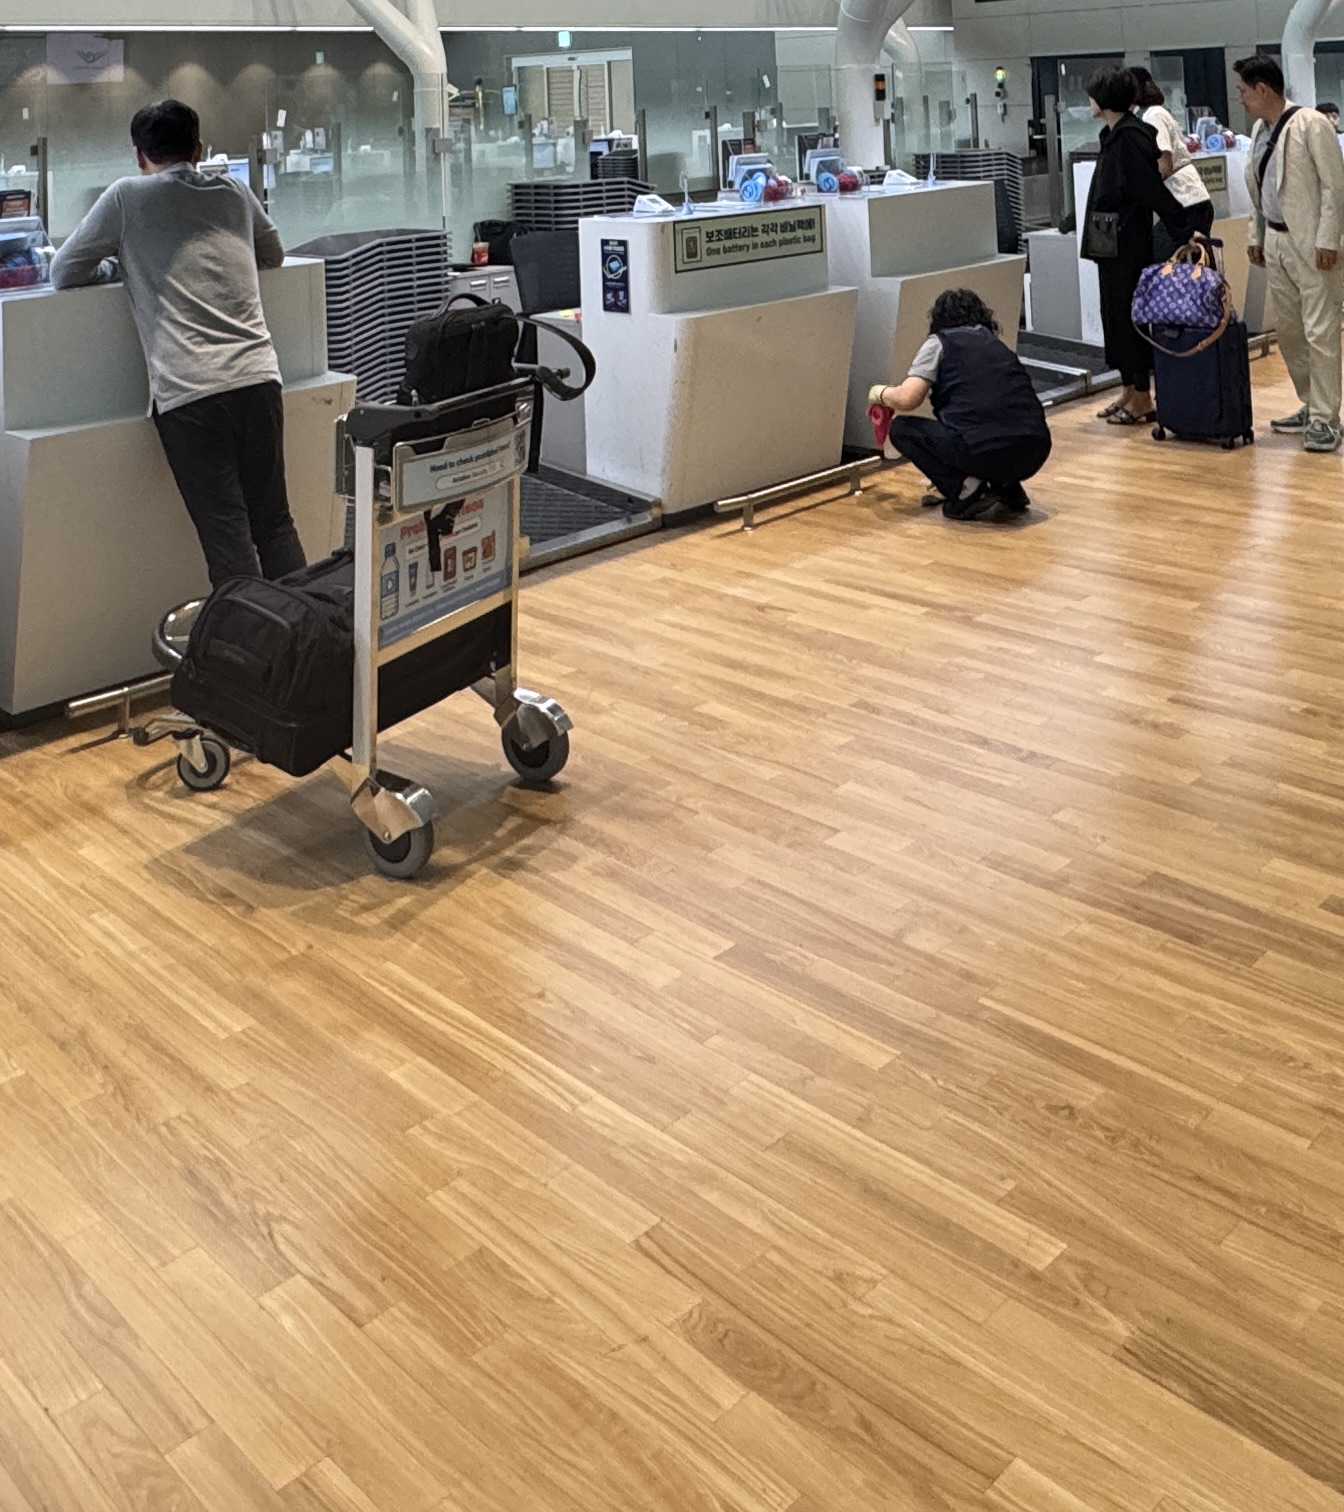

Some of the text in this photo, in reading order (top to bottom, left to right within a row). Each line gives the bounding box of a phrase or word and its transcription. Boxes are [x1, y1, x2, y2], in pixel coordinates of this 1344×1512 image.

[706, 246, 721, 257] One
[723, 242, 750, 254] battery
[760, 238, 777, 249] each
